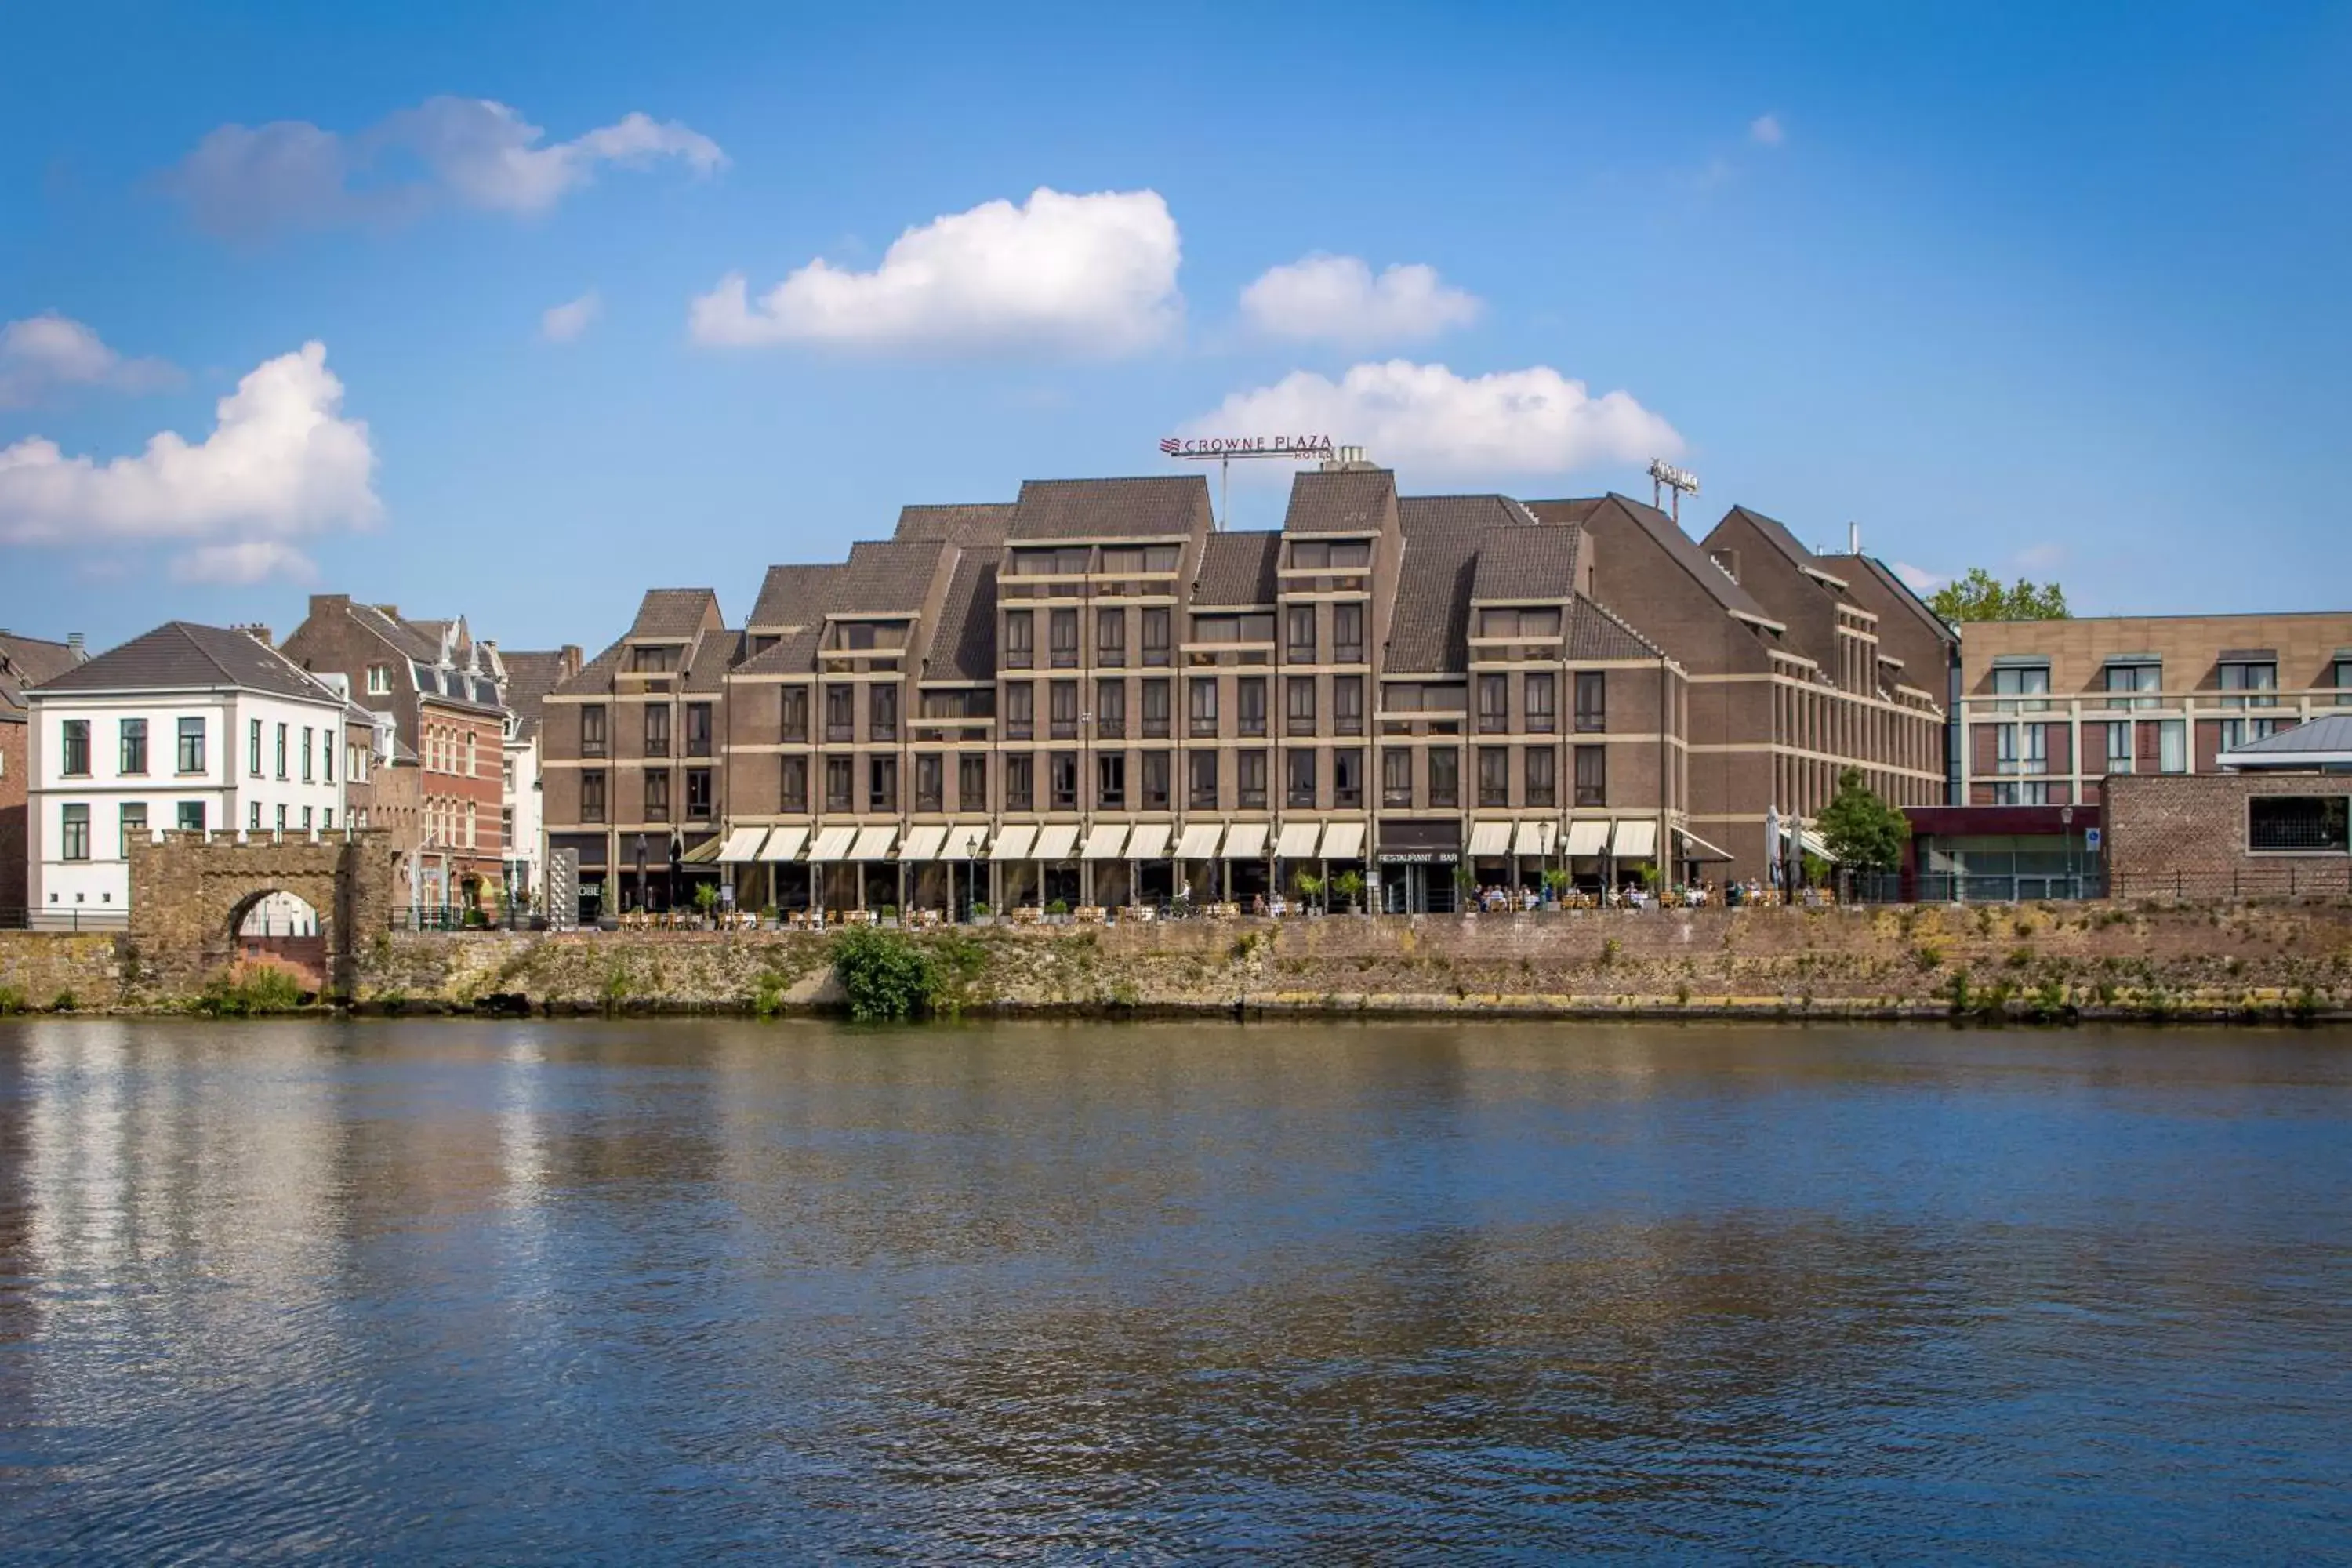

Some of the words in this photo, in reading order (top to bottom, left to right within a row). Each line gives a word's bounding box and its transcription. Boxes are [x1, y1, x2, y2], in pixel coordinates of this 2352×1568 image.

[1185, 437, 1265, 452] CROWNE
[1275, 434, 1331, 450] PLAZA
[1379, 853, 1432, 862] RESTAURANT
[1439, 853, 1457, 862] BAR
